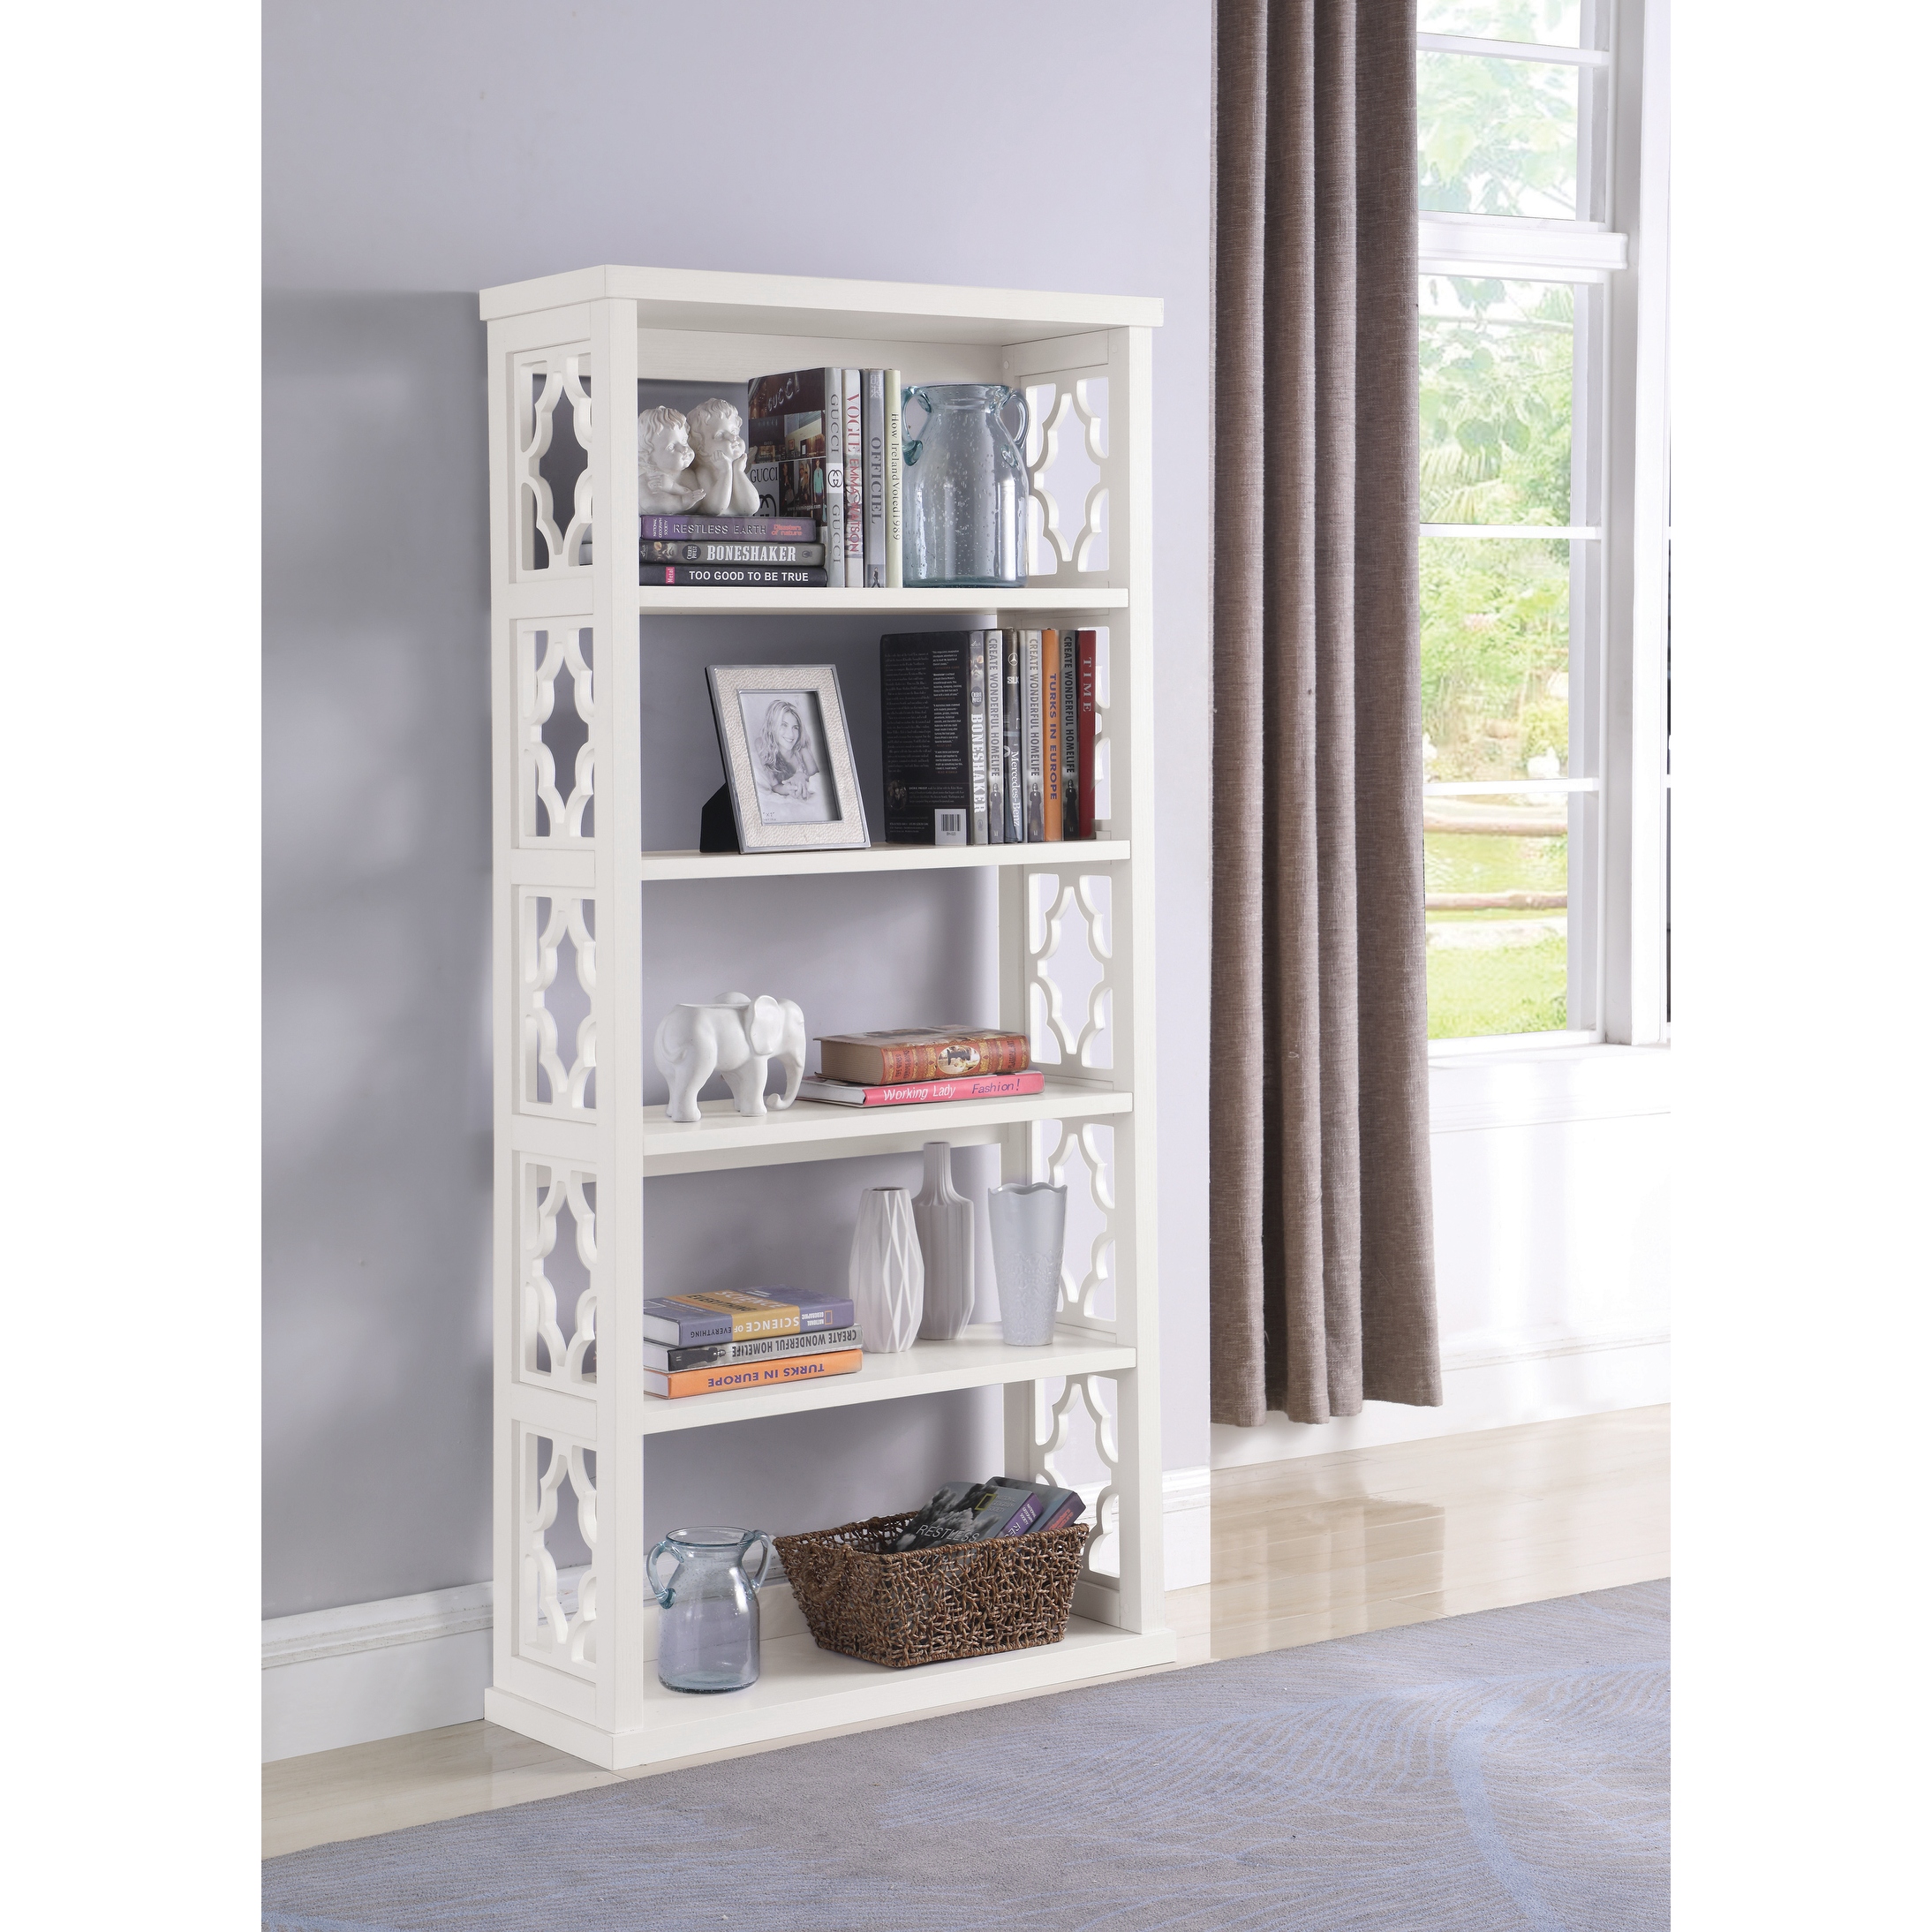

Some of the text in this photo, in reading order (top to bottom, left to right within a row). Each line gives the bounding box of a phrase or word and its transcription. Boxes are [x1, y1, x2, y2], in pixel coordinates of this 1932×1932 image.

[767, 372, 800, 411] GUCCI
[830, 394, 840, 453] GUCCI
[750, 466, 779, 483] GUCCI
[847, 393, 861, 552] VOGUE EMMA WATSON
[891, 442, 900, 480] Ireland
[871, 436, 882, 525] OFFICIEL
[673, 523, 766, 535] RESTLESS EARTH
[832, 504, 841, 562] GUCCI
[706, 545, 796, 562] BONESHAKER
[689, 570, 809, 582] TOO GOOD TO BE TRUE
[1083, 657, 1092, 712] TIME
[988, 638, 1000, 777] CREATE WONDERFUL HOMELIFE
[1029, 638, 1040, 777] CREATE WONDERFUL HOMELIFE
[1064, 636, 1075, 774] CREATE WONDERFUL HOMELIFE
[1049, 723, 1057, 739] IN
[971, 713, 986, 813] BONESHAKER
[1011, 751, 1021, 827] Mercedes-Benz
[883, 1087, 928, 1101] Working
[933, 1084, 956, 1098] Lady
[691, 1326, 732, 1338] EVERYTHING
[732, 1329, 857, 1357] CREATE WONDERFUL HOMELIFE
[746, 1317, 800, 1332] SCIENCE
[708, 1363, 825, 1387] TURKS IN EUROPE
[916, 1524, 980, 1543] RESTLESS
